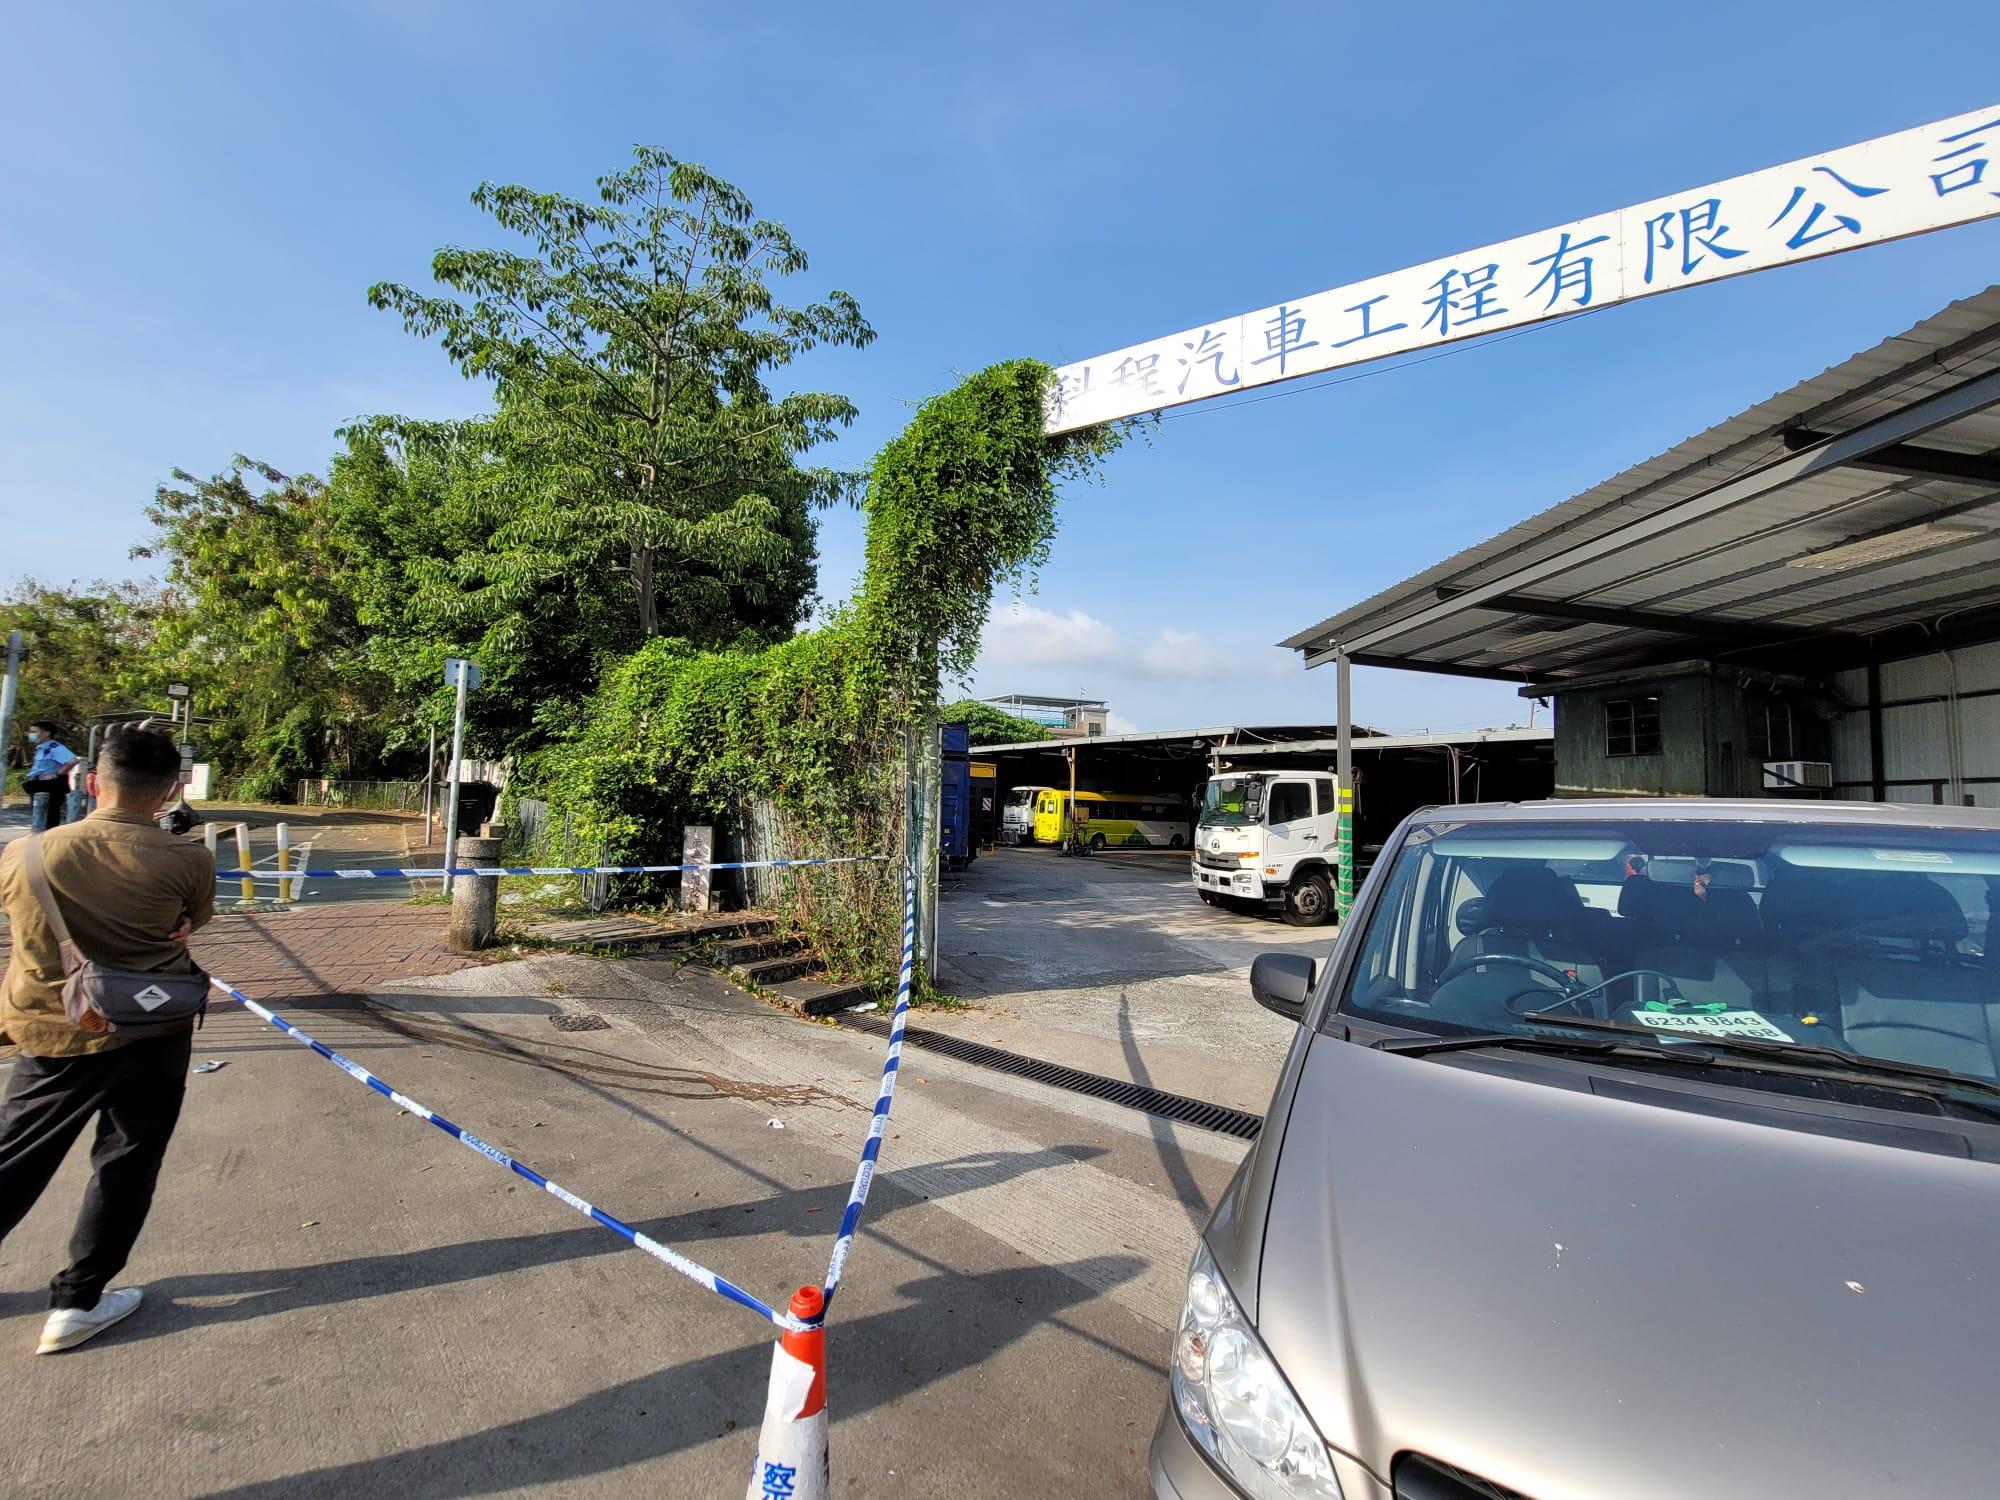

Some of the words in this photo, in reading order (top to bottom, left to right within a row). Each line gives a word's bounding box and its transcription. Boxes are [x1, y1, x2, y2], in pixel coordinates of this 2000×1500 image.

[1054, 119, 2000, 424] 科程汽車工程有限公司
[1645, 1016, 1699, 1026] 6234
[1703, 1016, 1761, 1026] 9843
